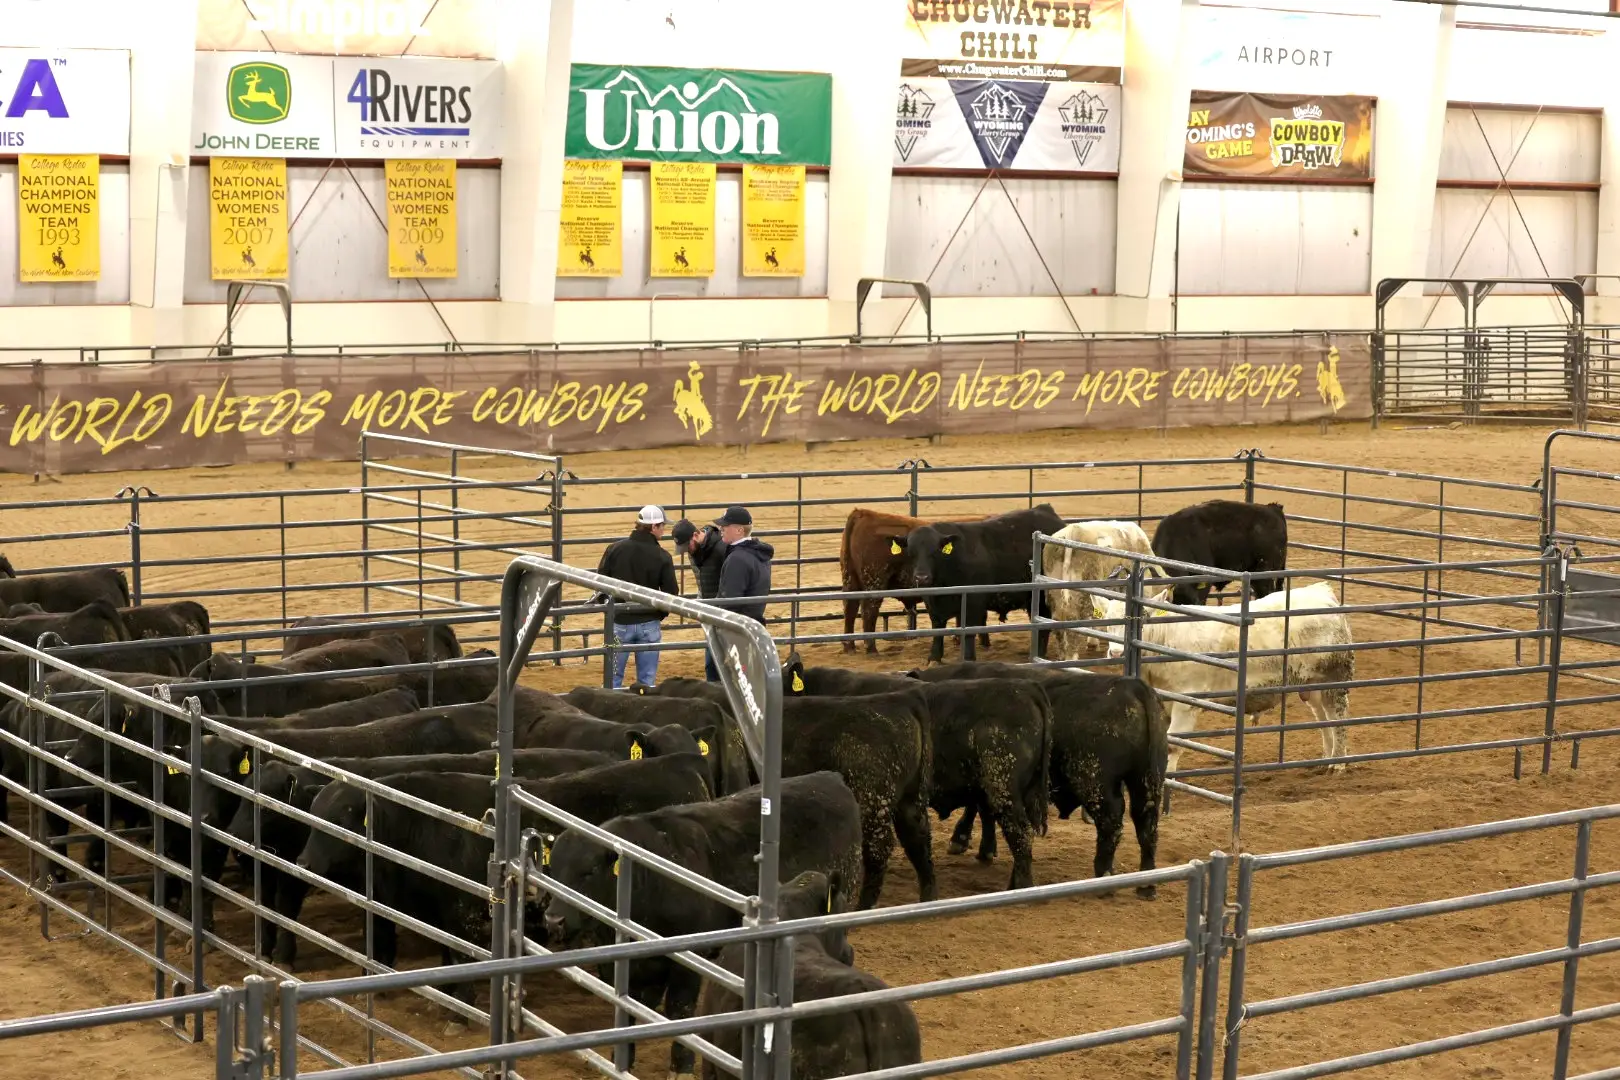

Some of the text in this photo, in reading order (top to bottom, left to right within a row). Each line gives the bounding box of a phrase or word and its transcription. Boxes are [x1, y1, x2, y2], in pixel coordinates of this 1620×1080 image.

[912, 0, 1092, 29] CHUGWATER
[960, 31, 1038, 59] CHILI
[1238, 46, 1333, 67] AIRPORT
[938, 63, 1067, 78] www.ChugwaterChili.com
[0, 59, 70, 118] A
[579, 82, 781, 155] Union
[974, 120, 1024, 131] WYOMING
[1188, 110, 1211, 127] AY
[1062, 124, 1106, 133] WYOMING
[1184, 122, 1256, 144] OMING'S
[1273, 124, 1342, 142] COWBOY
[195, 132, 320, 150] JOHN DEERE
[361, 139, 471, 148] EQUIPMENT
[1205, 140, 1254, 159] GAME
[1281, 143, 1333, 167] DRAW
[22, 176, 95, 186] NATIONAL
[213, 177, 283, 187] NATIONAL
[388, 178, 452, 188] NATIONAL
[20, 189, 97, 200] CHAMPION
[211, 190, 285, 200] CHAMPION
[388, 192, 454, 201] CHAMPION
[26, 203, 91, 214] WOMENS
[217, 204, 279, 214] WOMENS
[393, 205, 449, 214] WOMENS
[39, 217, 78, 228] TEAM
[230, 217, 267, 227] TEAM
[404, 218, 438, 227] TEAM
[37, 228, 80, 246] 1993
[223, 228, 273, 245] 2007
[399, 228, 444, 244] 2009
[736, 357, 1303, 437] THE WORLD NEEDS MORE COWBOYS.
[9, 375, 649, 455] WORLD NEEDS MORE COWBOYS.
[631, 752, 642, 760] 12
